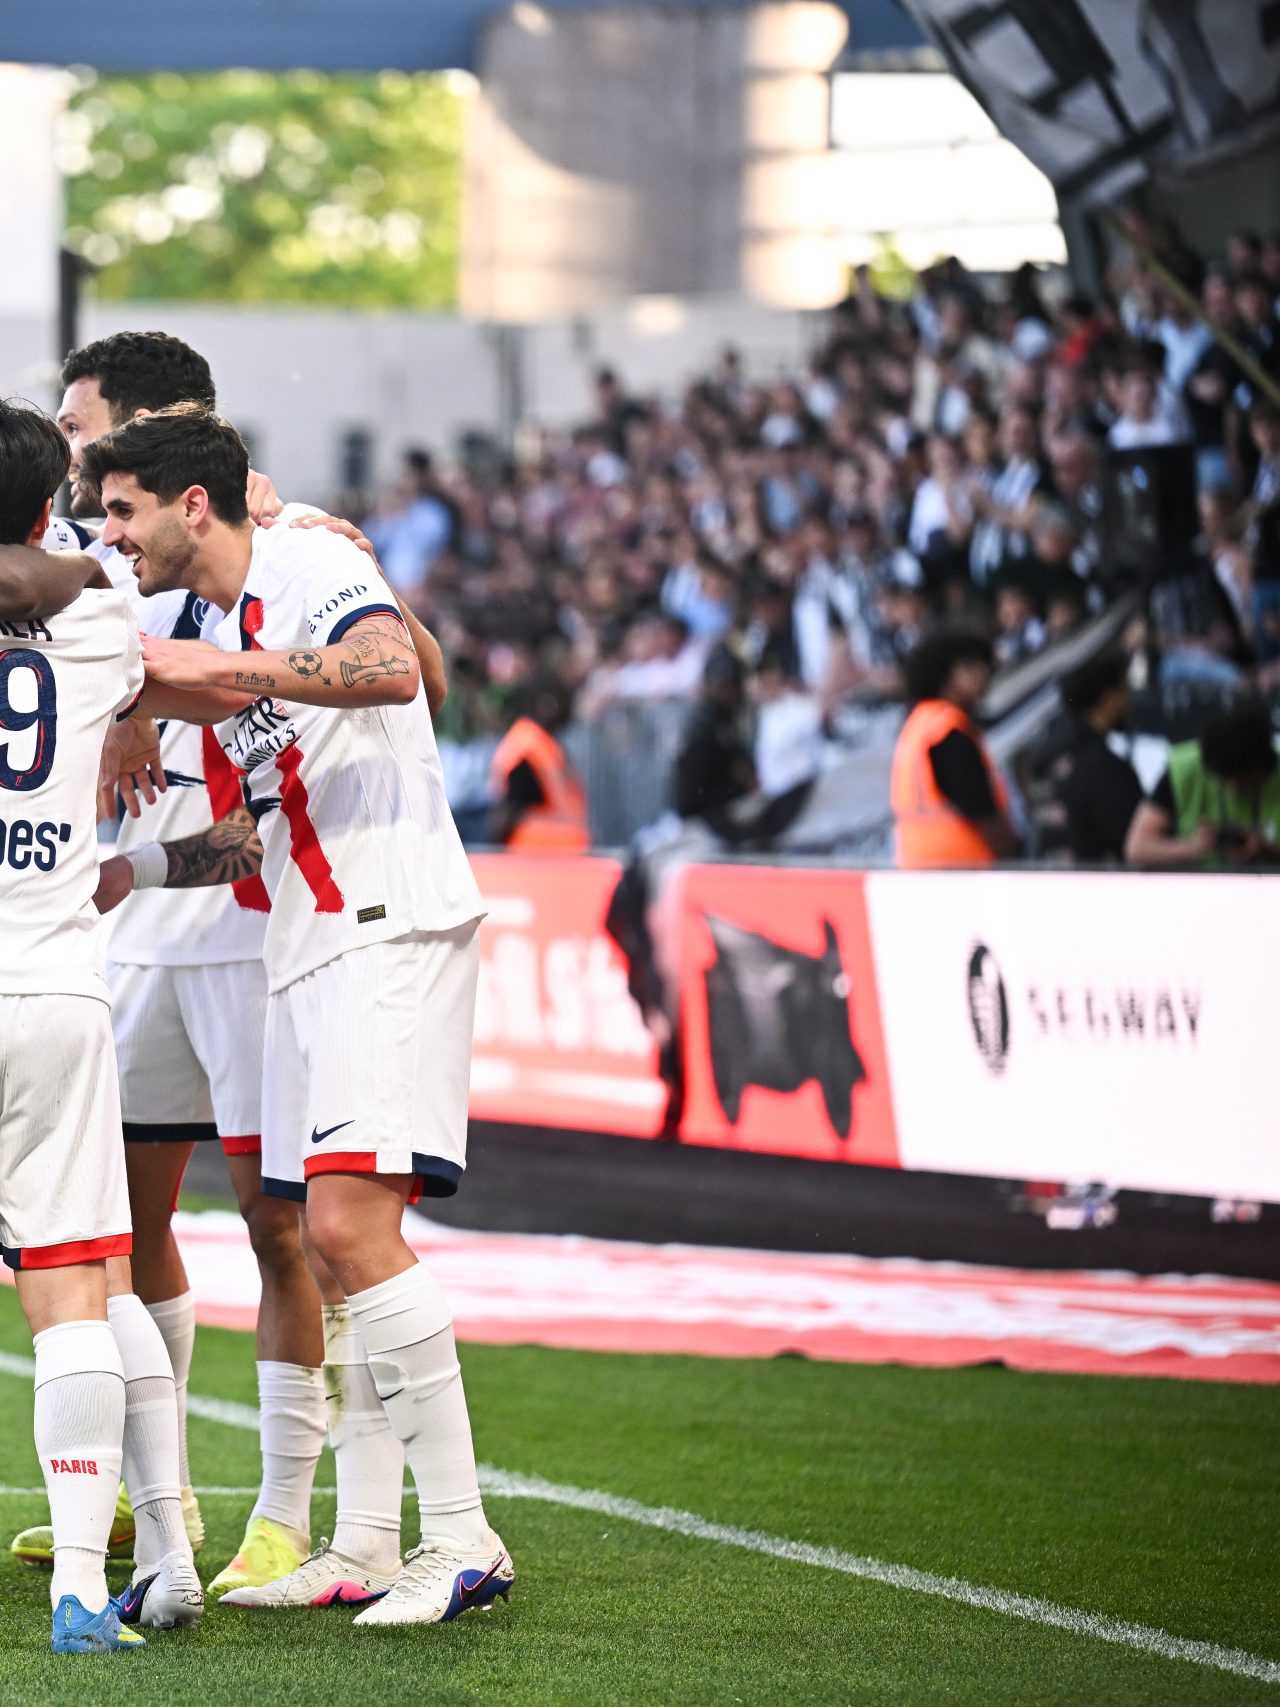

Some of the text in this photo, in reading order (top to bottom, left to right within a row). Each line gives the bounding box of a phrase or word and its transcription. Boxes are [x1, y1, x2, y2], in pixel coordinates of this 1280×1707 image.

[309, 584, 368, 635] EYOND
[235, 672, 276, 688] Rafaela
[50, 1459, 99, 1476] PARIS
